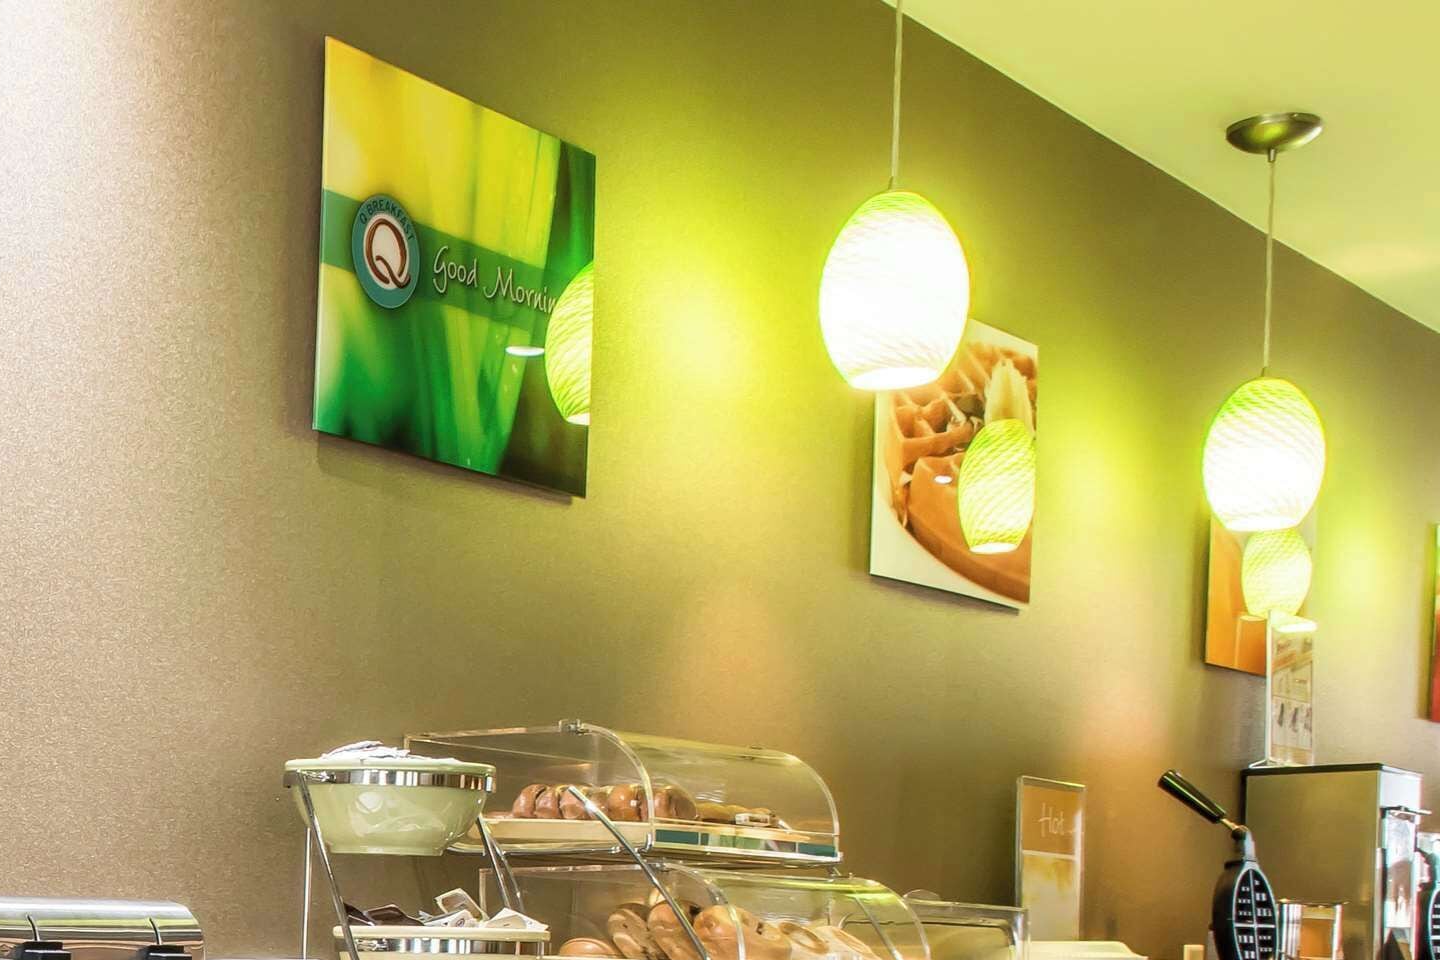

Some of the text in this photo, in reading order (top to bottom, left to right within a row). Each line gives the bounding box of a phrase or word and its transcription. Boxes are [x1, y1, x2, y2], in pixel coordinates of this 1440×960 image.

[365, 217, 411, 289] Q
[366, 199, 416, 240] BREAKFAST
[432, 245, 558, 315] Good Mornin
